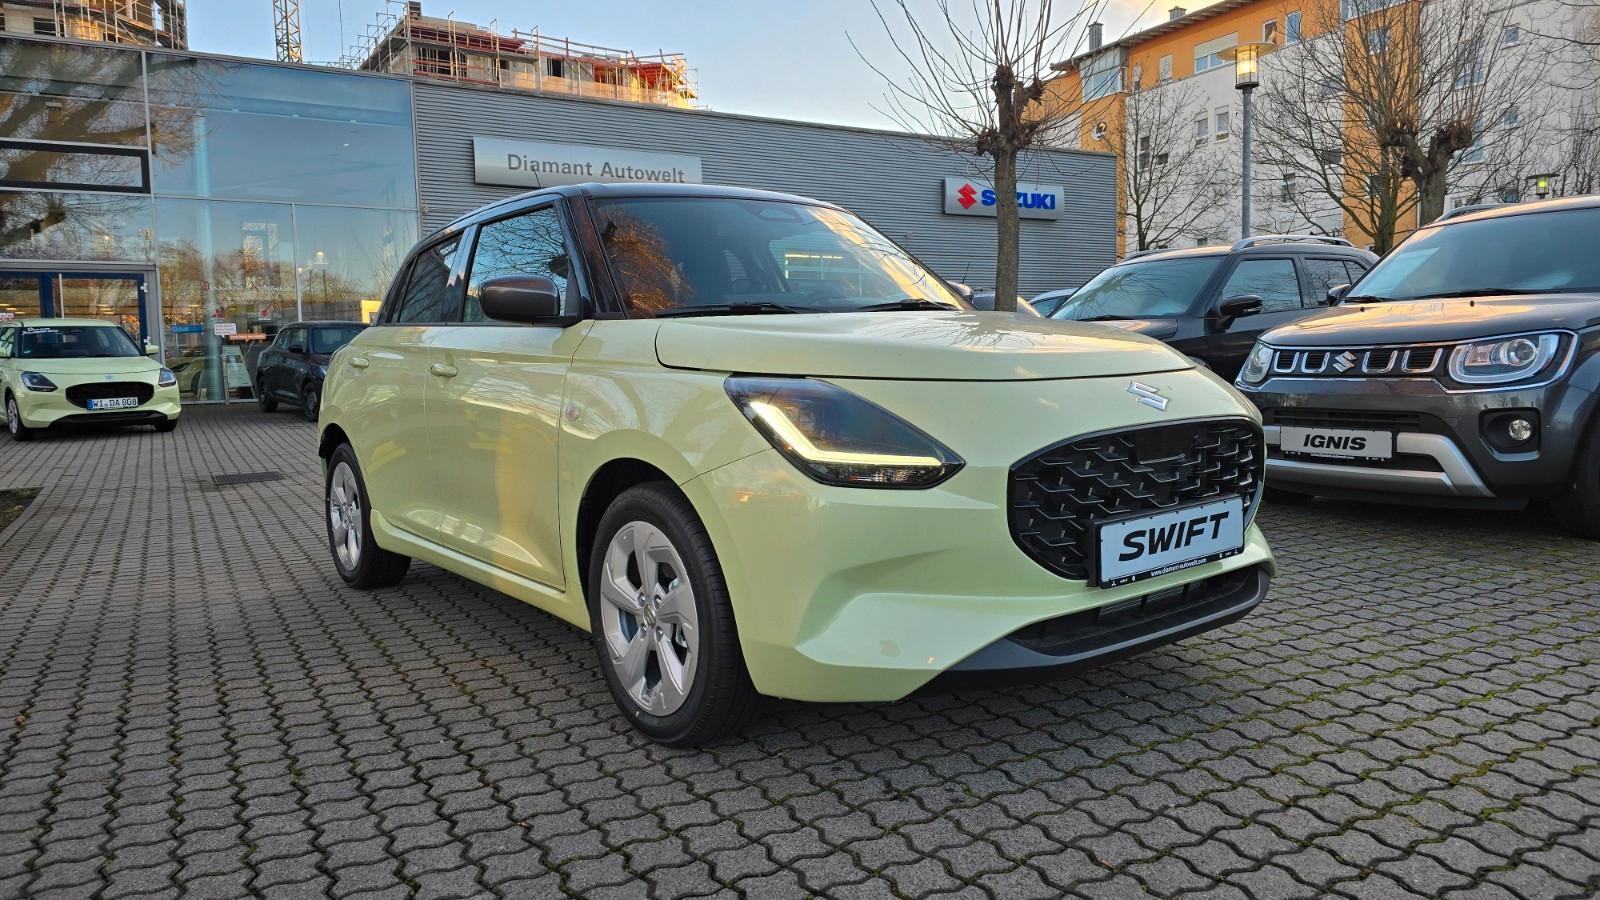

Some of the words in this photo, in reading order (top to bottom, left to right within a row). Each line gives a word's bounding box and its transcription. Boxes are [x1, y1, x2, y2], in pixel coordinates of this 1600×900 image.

[507, 153, 593, 177] Diamant
[600, 161, 685, 184] Autowelt
[1303, 434, 1367, 451] IGNIS
[1118, 511, 1230, 562] SWIFT
